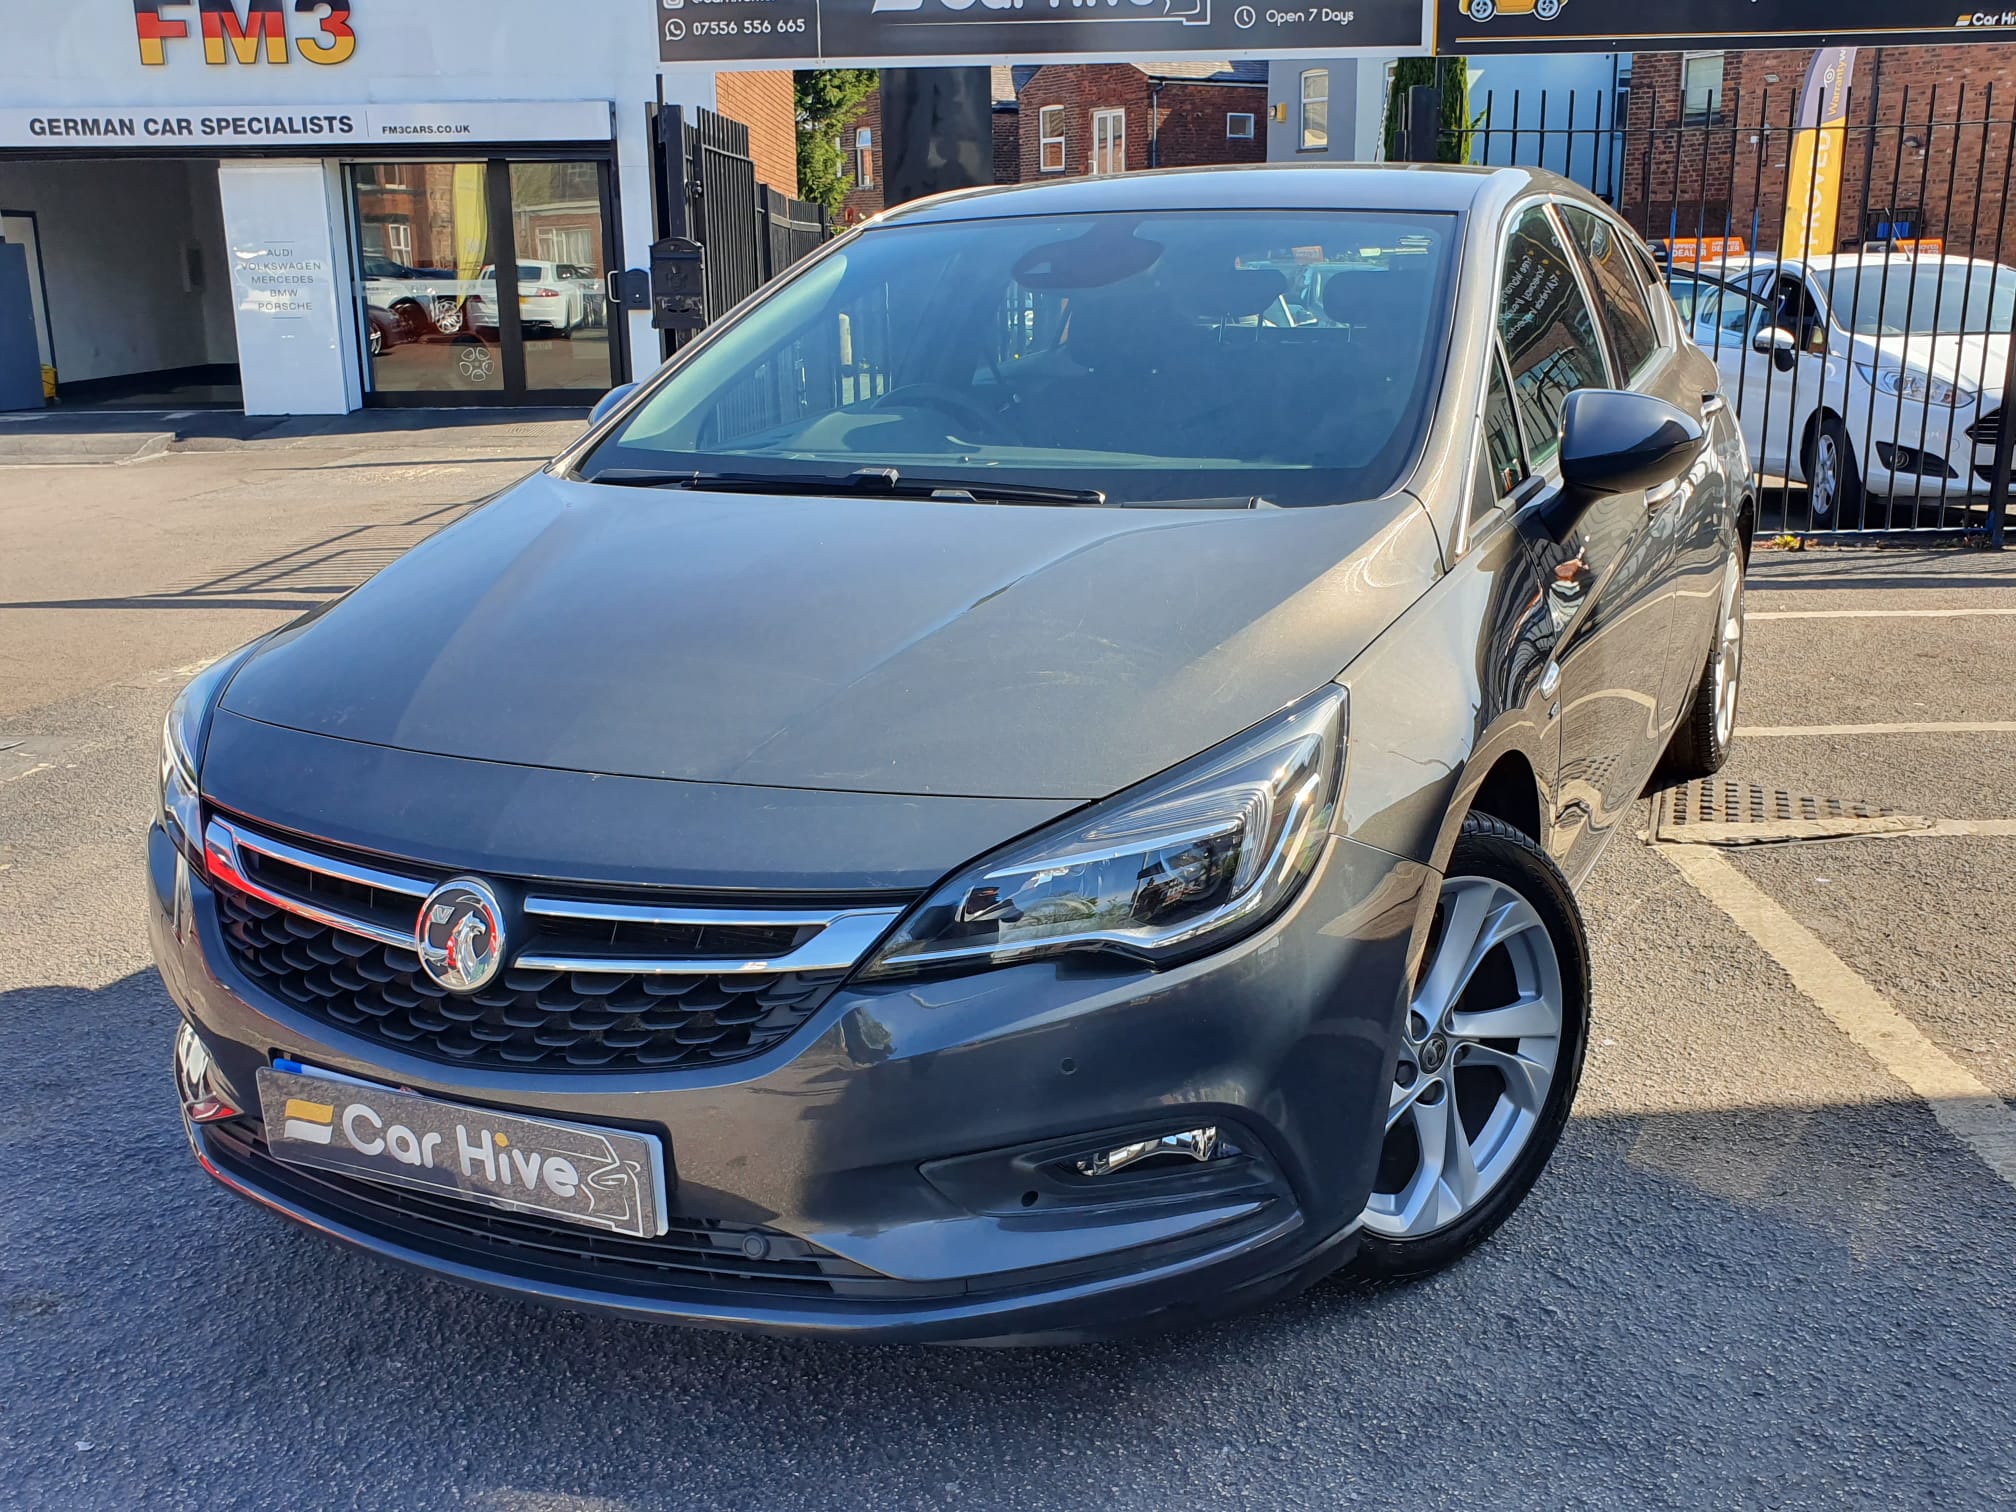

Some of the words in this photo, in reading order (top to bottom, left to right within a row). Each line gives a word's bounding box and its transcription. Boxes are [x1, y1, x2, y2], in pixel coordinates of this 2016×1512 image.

[1265, 9, 1304, 26] Open
[1308, 8, 1318, 22] 7
[1321, 8, 1354, 25] Days
[1972, 12, 1999, 26] Car
[2001, 11, 2016, 25] Hi
[134, 0, 357, 65] FM3
[692, 21, 738, 36] 07556
[743, 20, 772, 34] 556
[777, 19, 806, 33] 665
[29, 118, 136, 136] GERMAN
[143, 117, 193, 136] CAR
[201, 116, 354, 135] SPECIALISTS
[382, 125, 471, 135] FM3CARS.CO.UK
[266, 248, 293, 257] AUDI
[1672, 249, 1707, 257] DEALR
[241, 262, 321, 271] VOLKSWAGEN
[251, 275, 314, 284] MERCEDES
[269, 289, 298, 298] BMW
[258, 302, 313, 311] PORSCHE
[343, 1103, 442, 1169] Car
[455, 1124, 580, 1198] Hive
